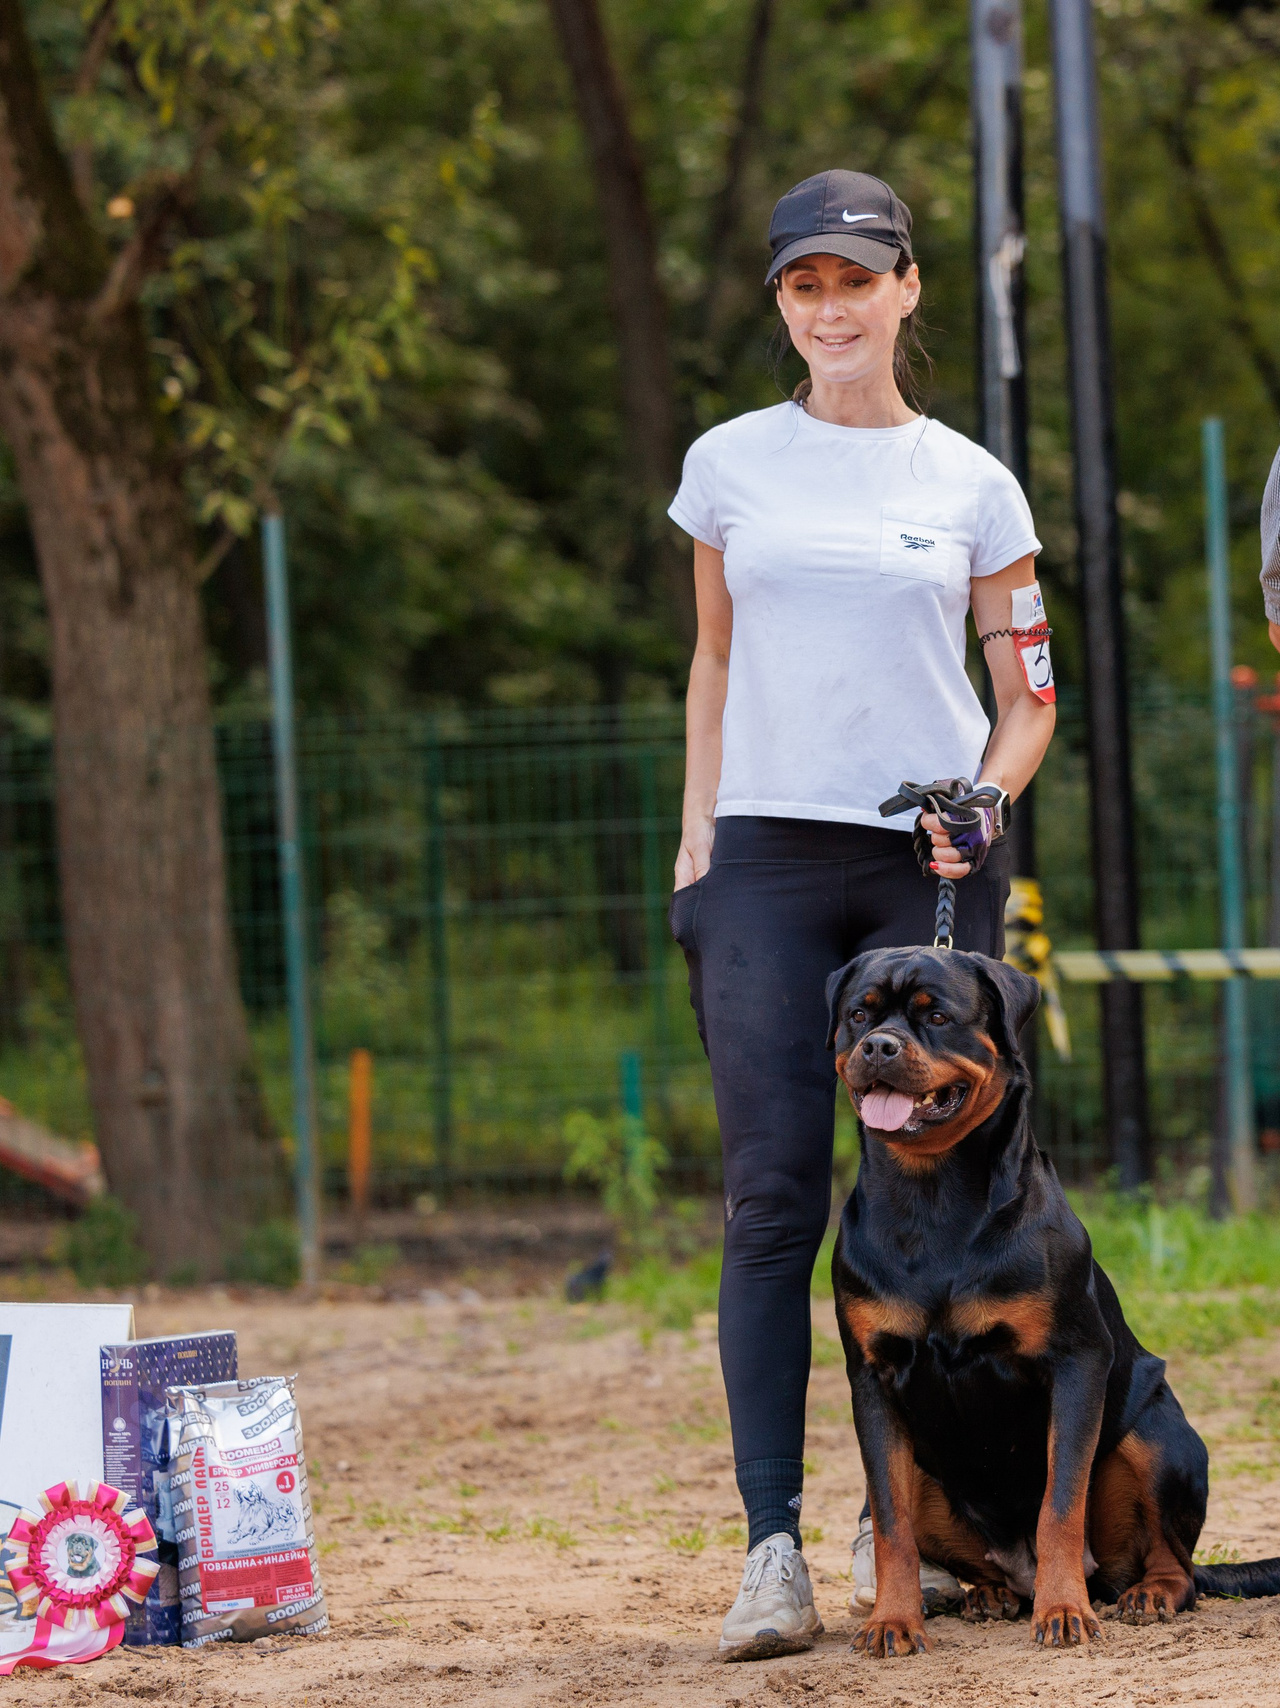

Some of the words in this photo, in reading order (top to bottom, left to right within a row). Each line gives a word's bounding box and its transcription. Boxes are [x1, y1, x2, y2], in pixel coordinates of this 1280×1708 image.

[900, 533, 936, 546] Reebok
[220, 1439, 280, 1461] ЗООМЕНЮ
[213, 1467, 243, 1477] БРИДЕР
[245, 1457, 296, 1475] УНИВЕРСАЛ
[214, 1481, 230, 1492] 25
[216, 1498, 231, 1509] 12
[196, 1495, 214, 1559] БРИДЕР
